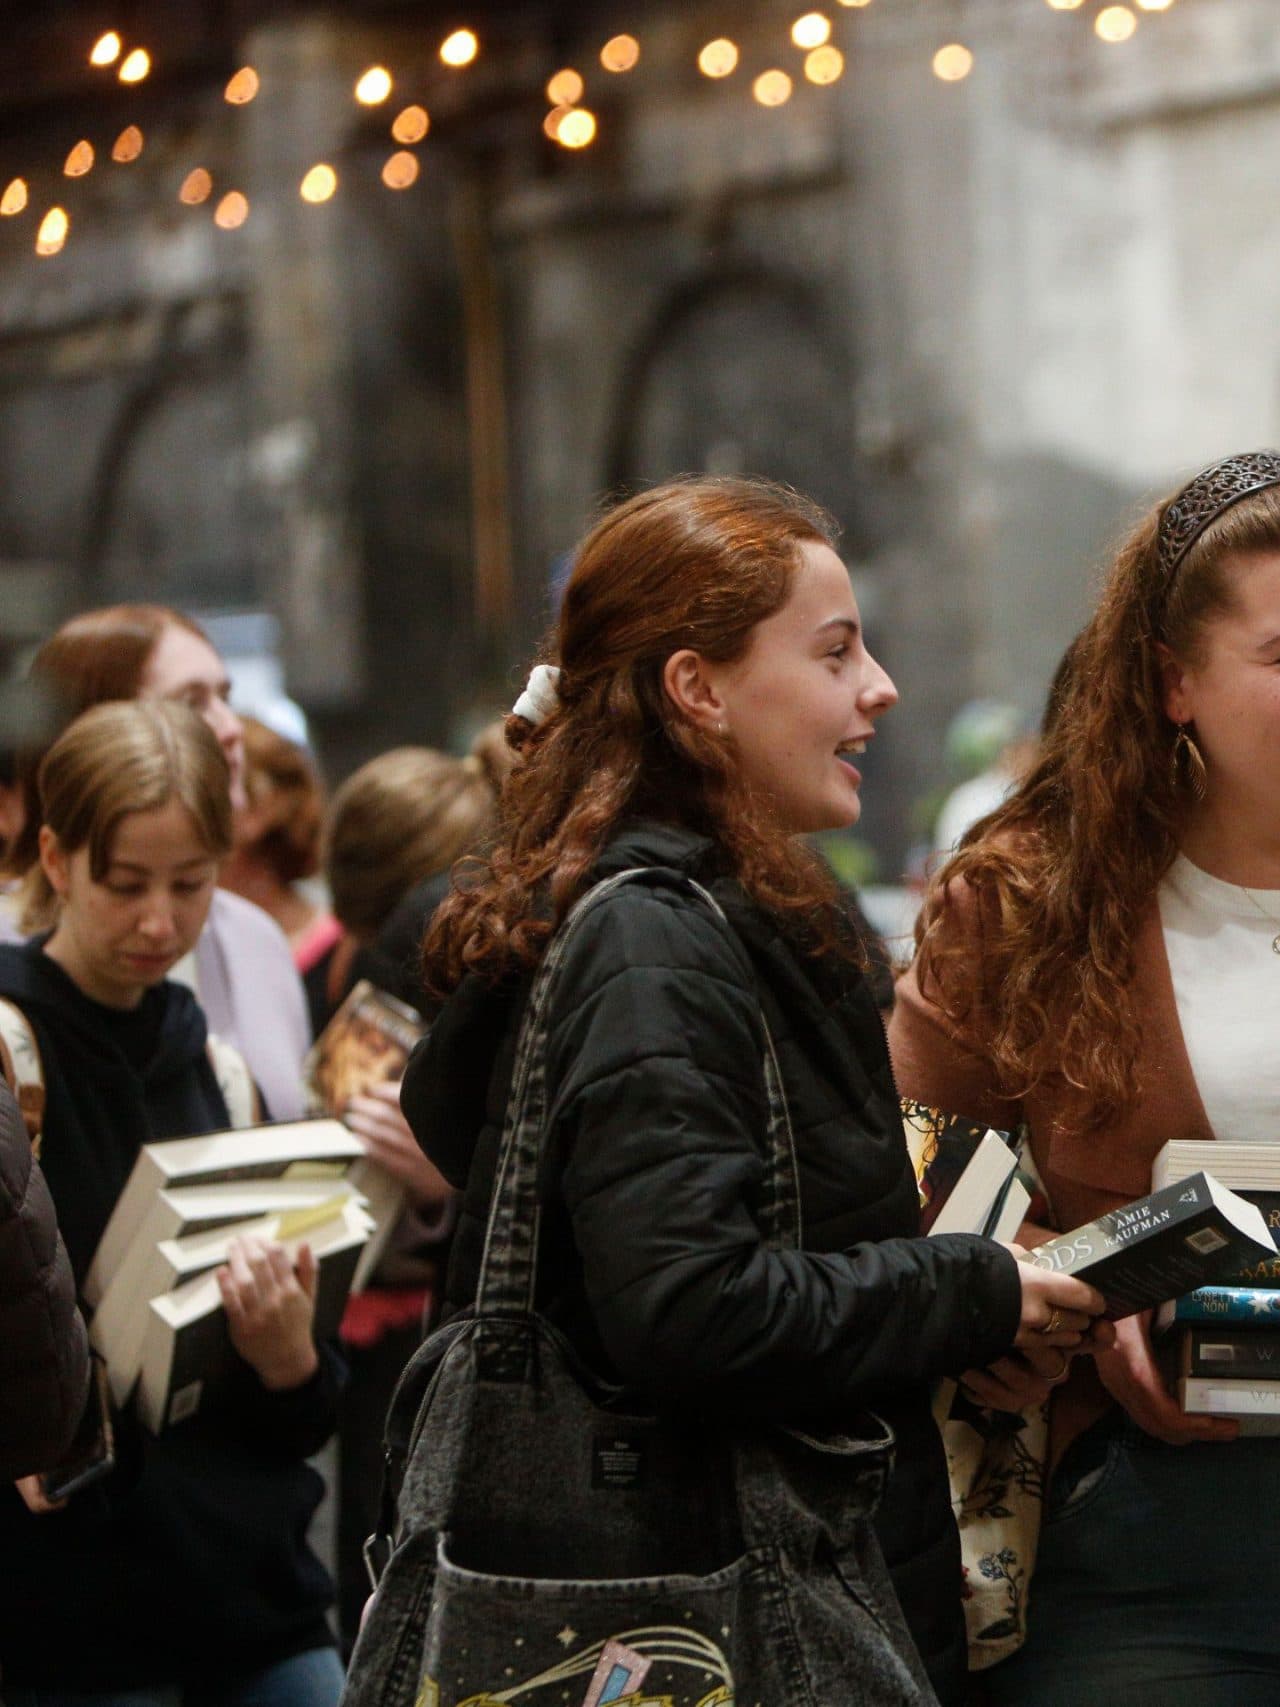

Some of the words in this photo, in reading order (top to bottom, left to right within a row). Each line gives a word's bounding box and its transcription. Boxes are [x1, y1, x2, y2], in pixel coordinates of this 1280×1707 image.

[1116, 1205, 1151, 1230] AMIE
[1103, 1209, 1171, 1249] KAUFMAN
[1191, 1290, 1240, 1304] LYNETTE
[1202, 1301, 1229, 1313] NONI
